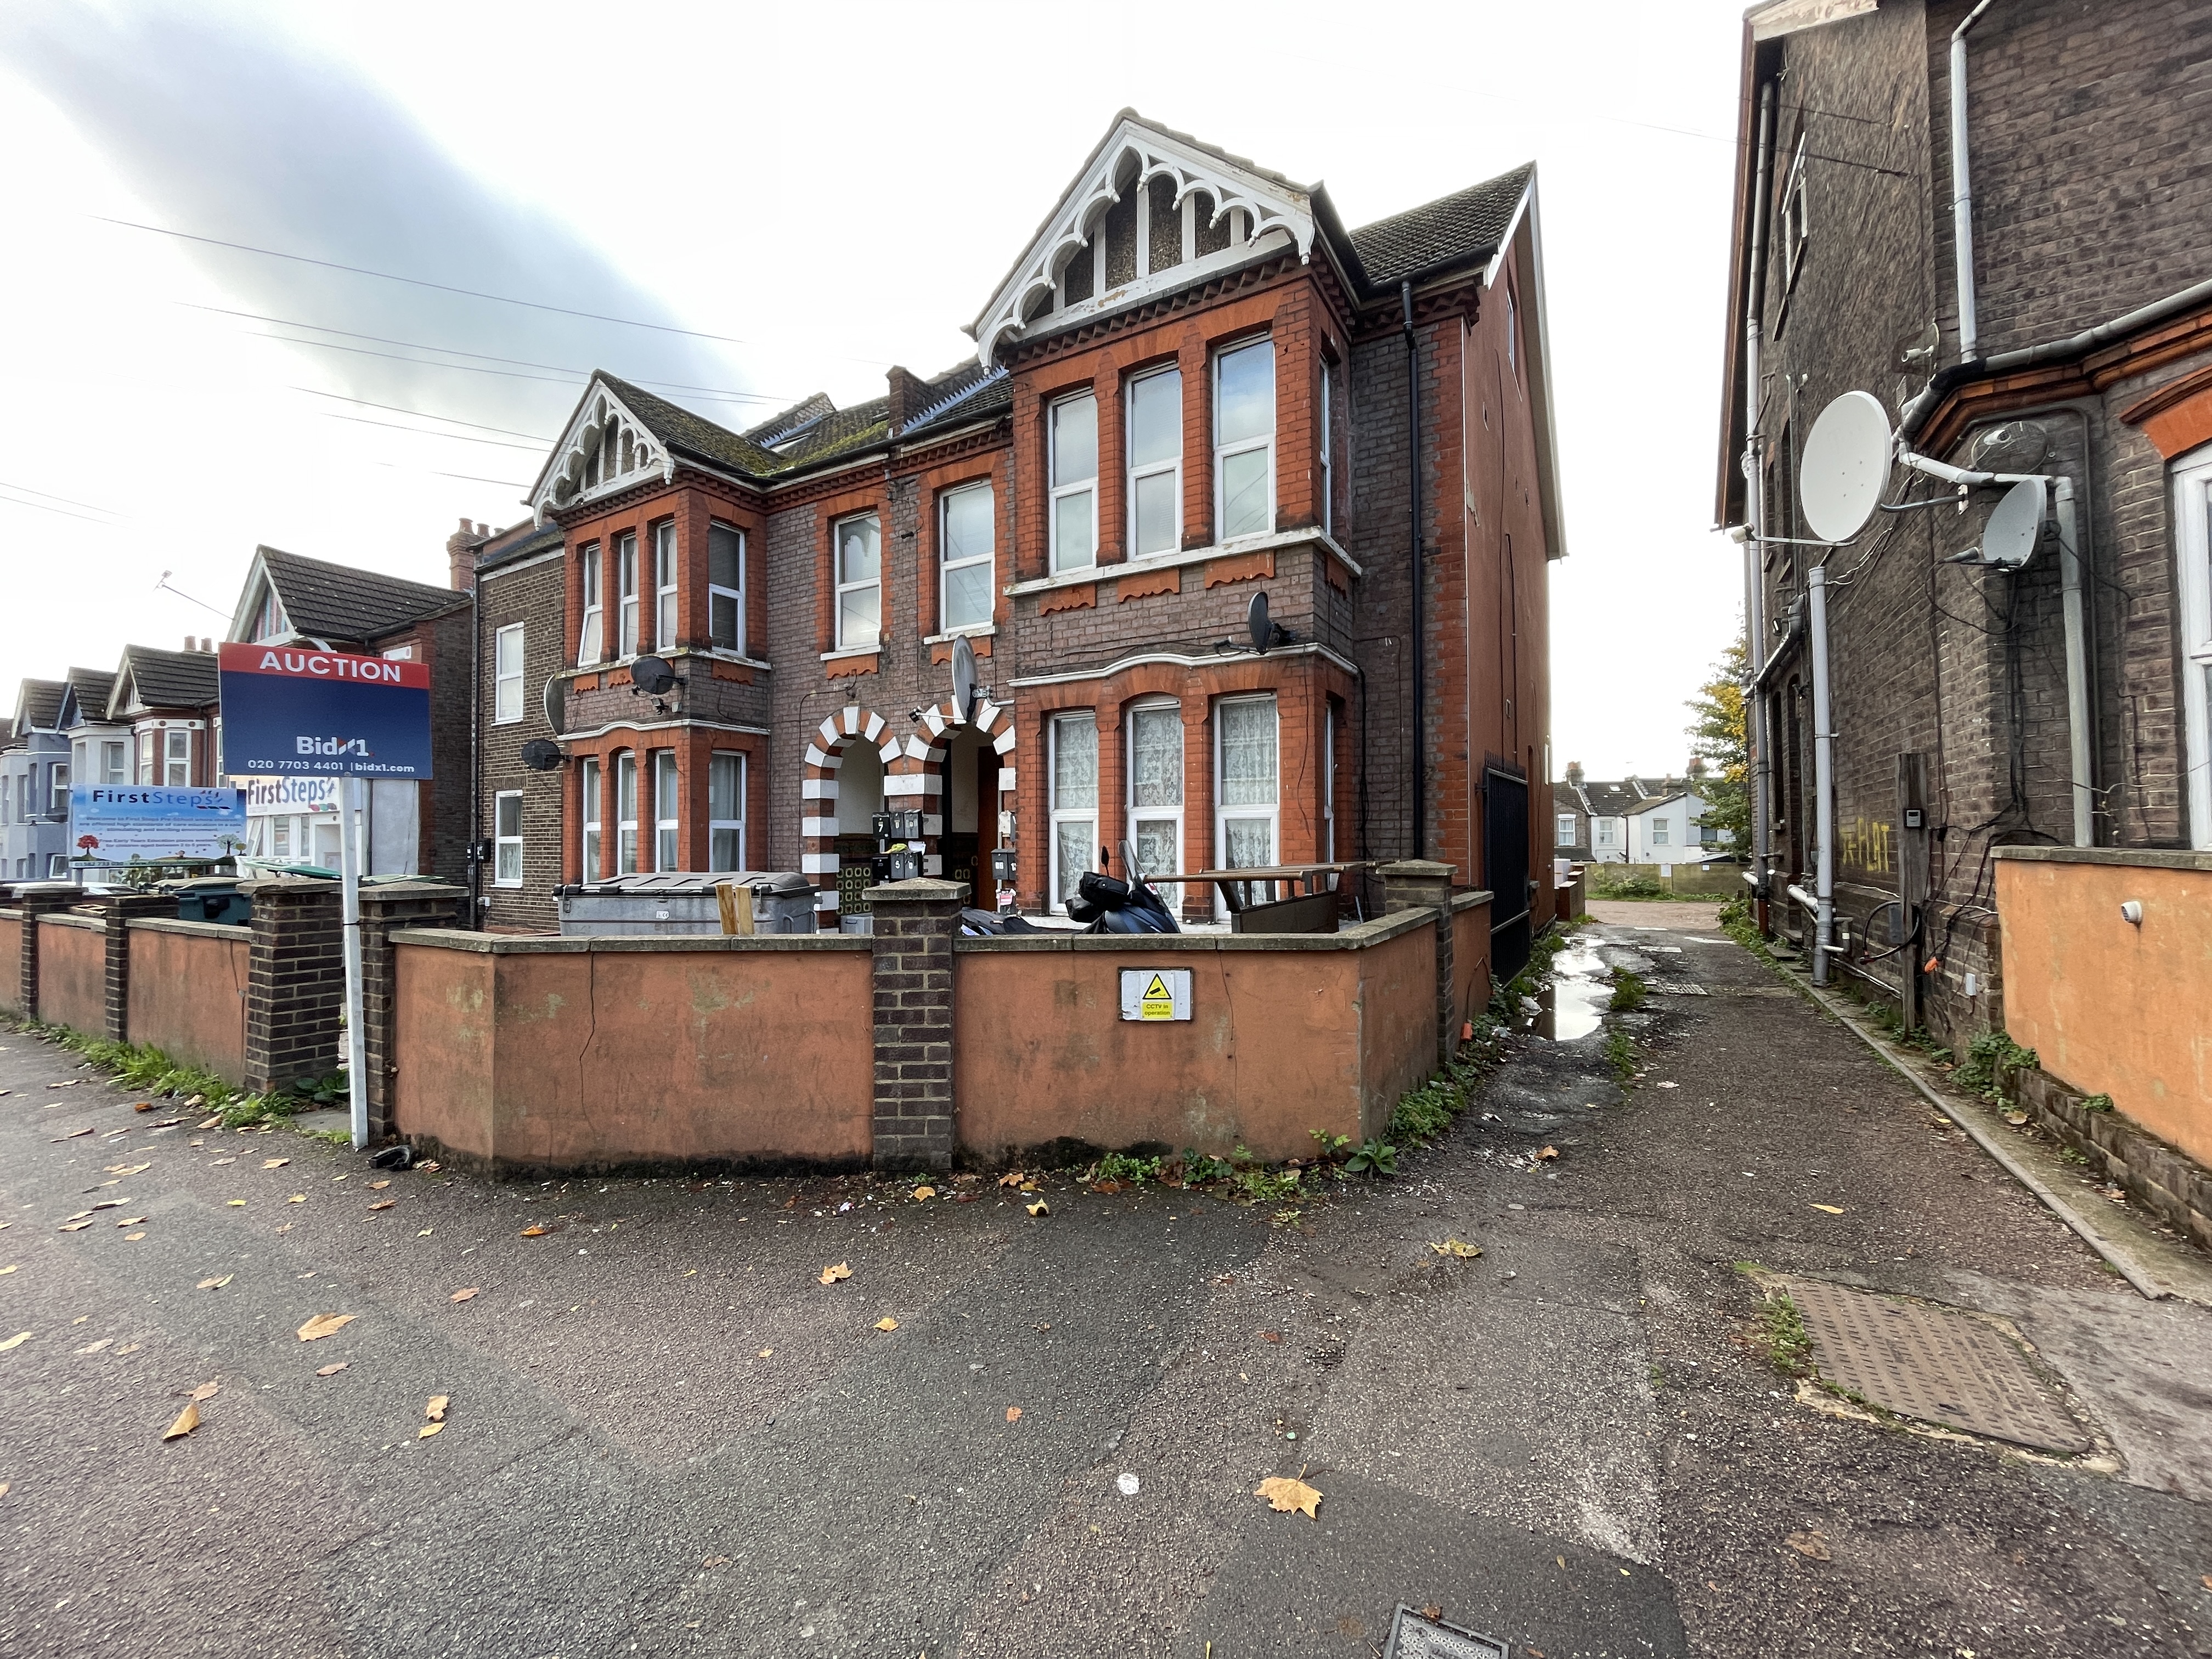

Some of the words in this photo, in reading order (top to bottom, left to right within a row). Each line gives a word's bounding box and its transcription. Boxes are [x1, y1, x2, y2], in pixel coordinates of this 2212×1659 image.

[259, 651, 400, 682] AUCTION
[247, 760, 274, 769] 020
[278, 760, 309, 769] 7703
[313, 761, 343, 770] 4401
